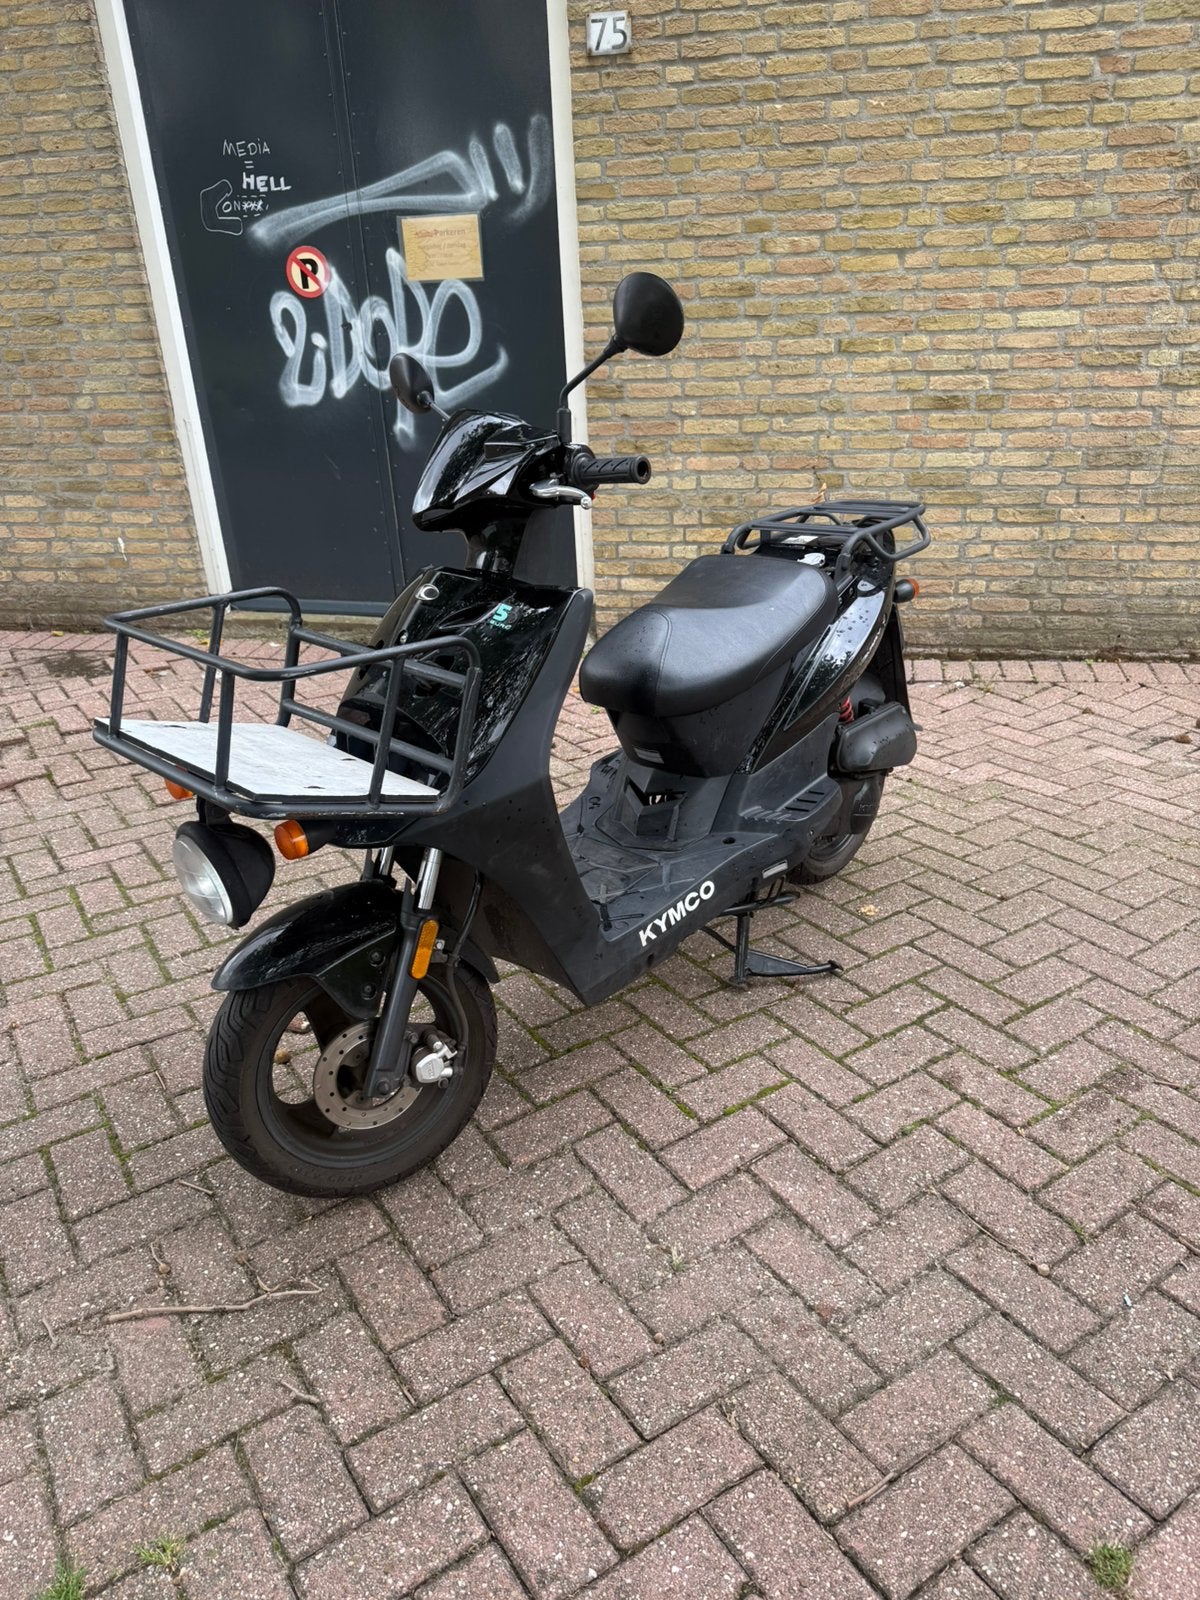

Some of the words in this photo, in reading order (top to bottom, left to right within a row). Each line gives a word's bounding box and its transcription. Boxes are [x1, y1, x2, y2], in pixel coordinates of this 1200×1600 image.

[591, 16, 628, 51] 75
[242, 171, 292, 192] HELL
[299, 258, 319, 290] P
[492, 603, 513, 622] 5
[638, 880, 715, 947] KYMCO
